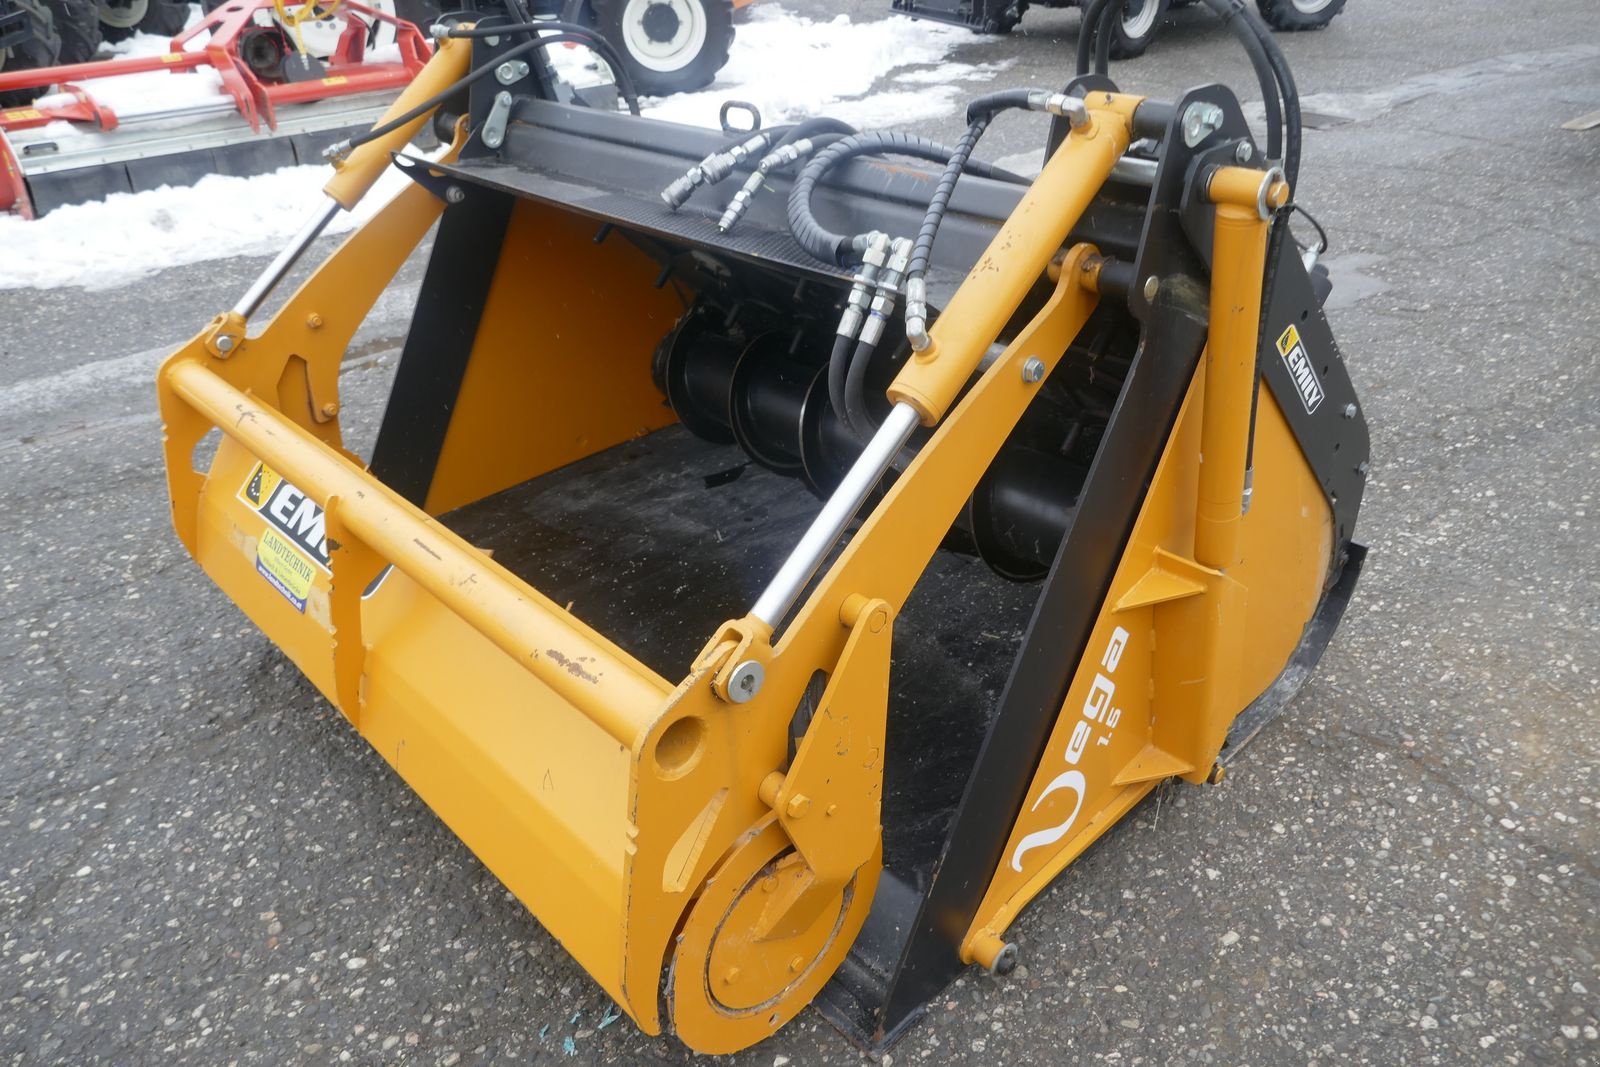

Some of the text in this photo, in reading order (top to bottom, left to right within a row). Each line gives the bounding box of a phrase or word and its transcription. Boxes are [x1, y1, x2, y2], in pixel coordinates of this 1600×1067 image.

[1287, 345, 1321, 407] EMILY
[263, 530, 313, 583] LANDTECHNIK
[1096, 706, 1122, 747] 1.5
